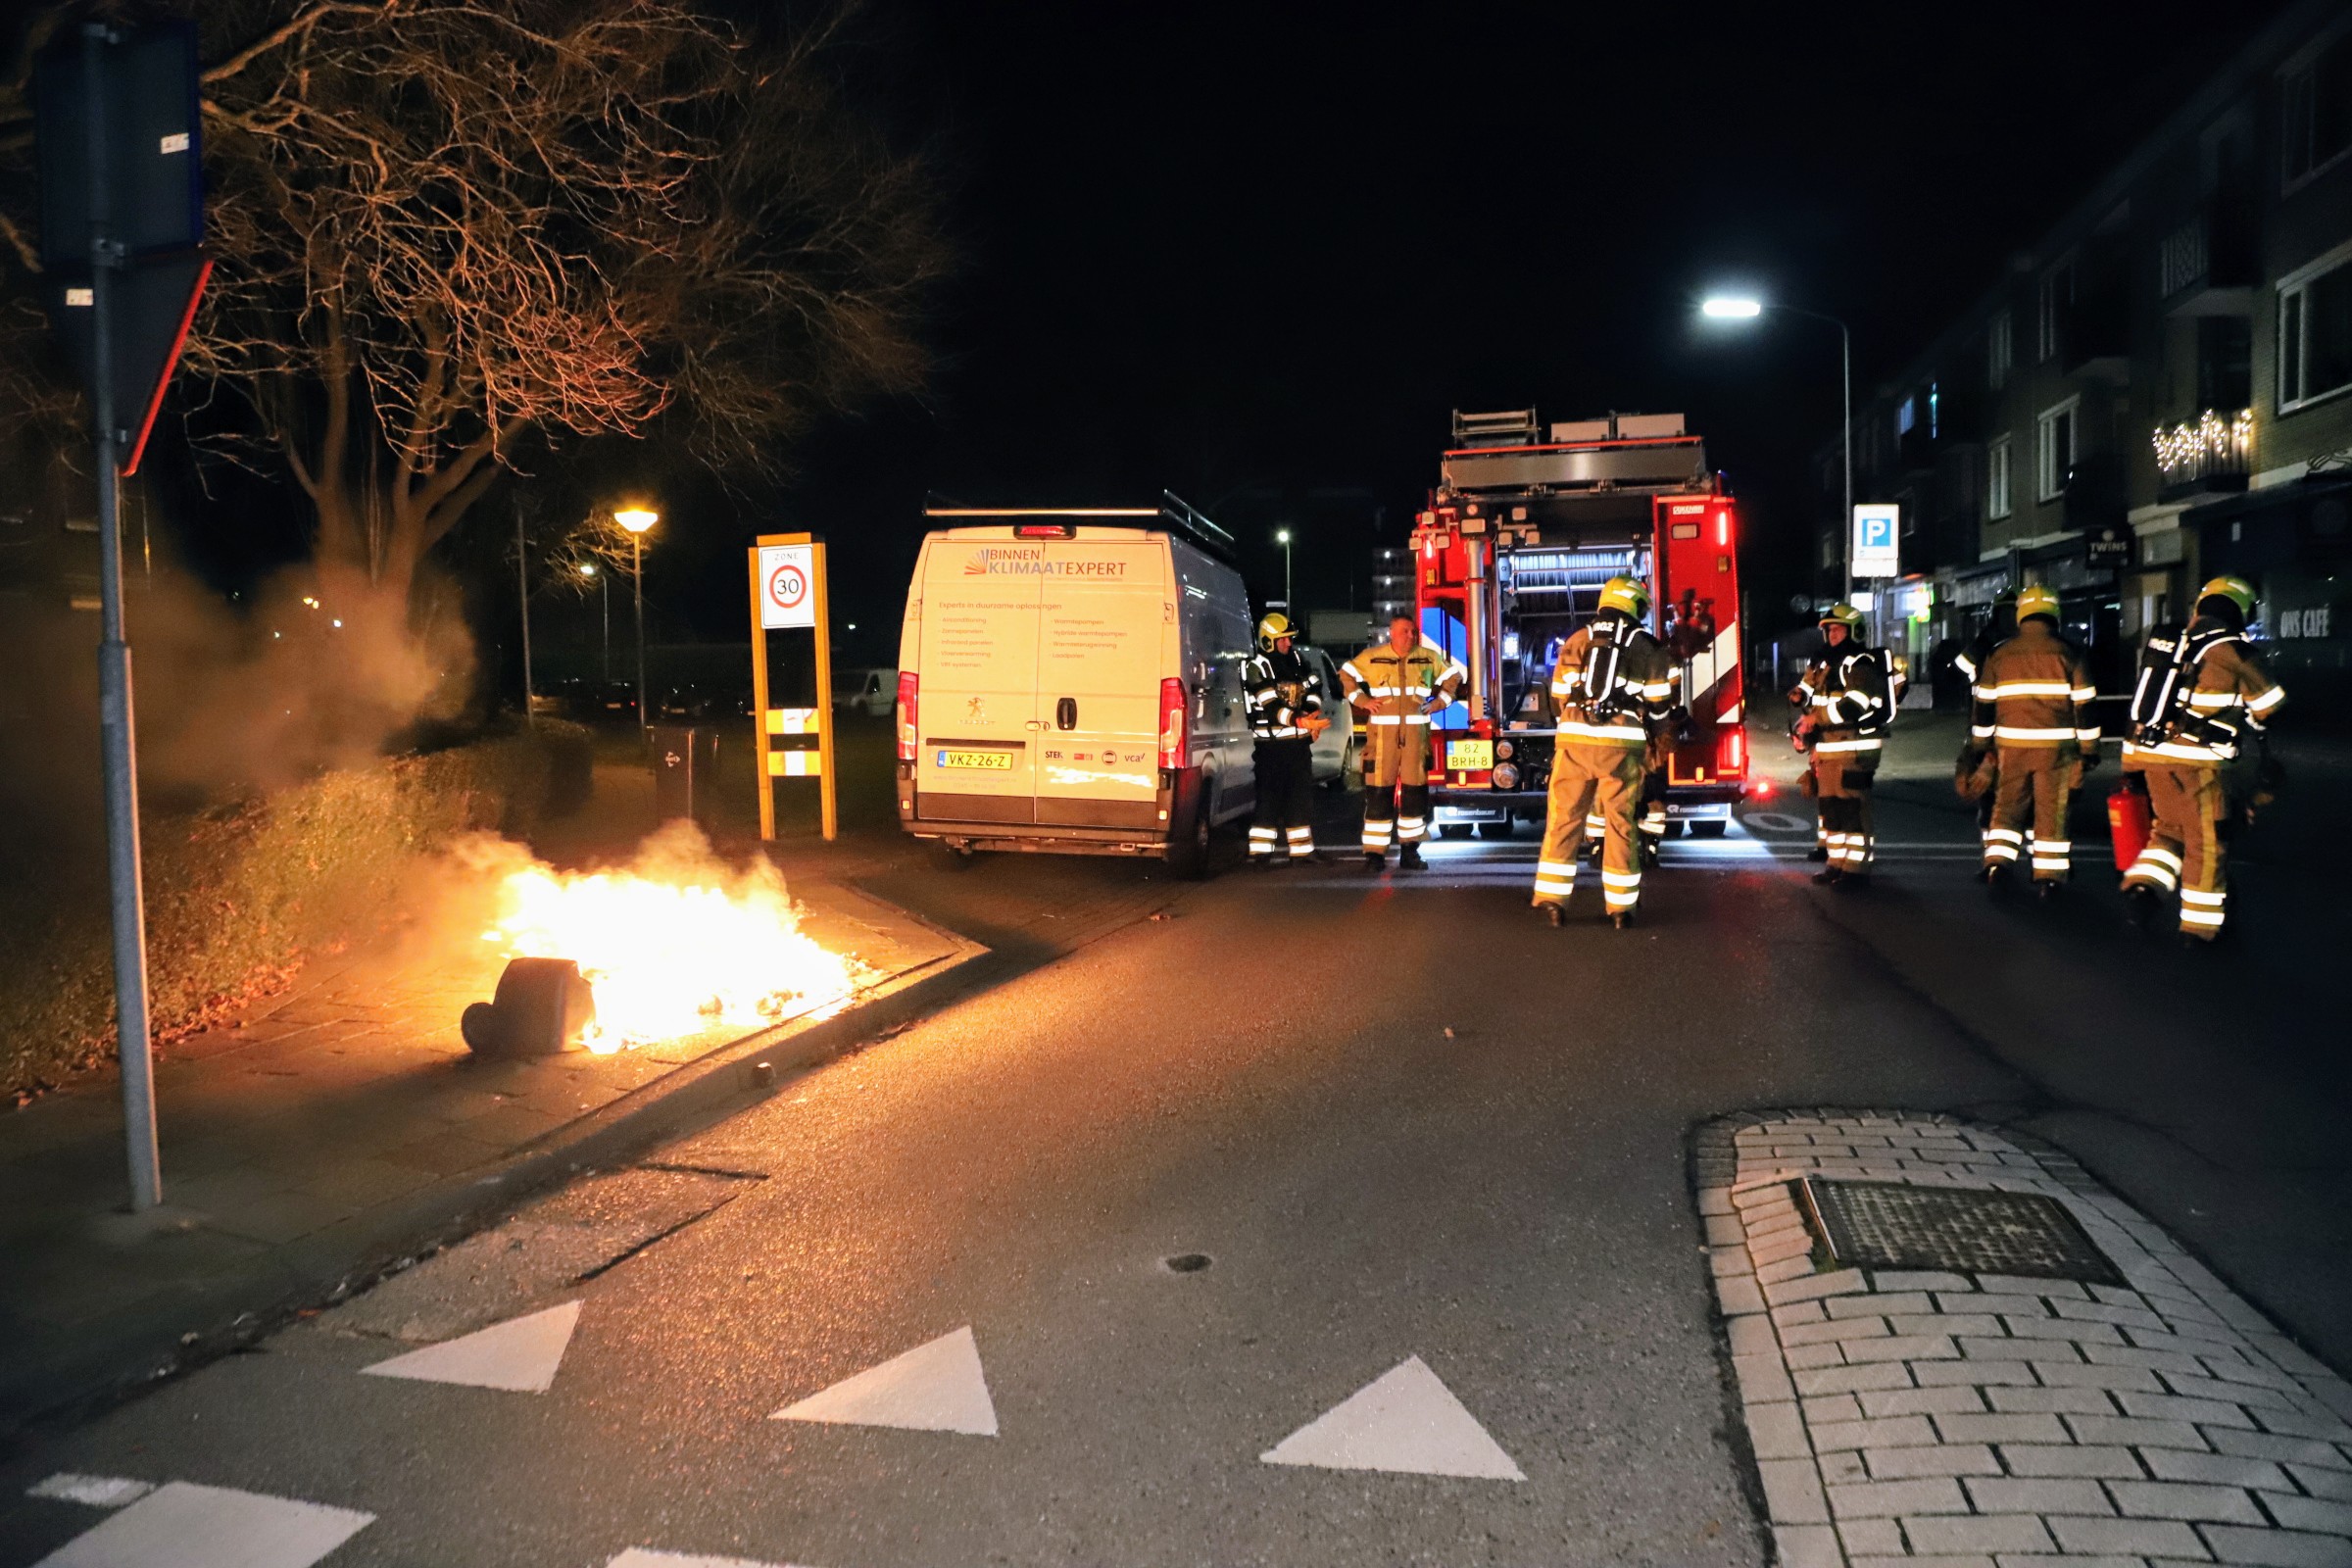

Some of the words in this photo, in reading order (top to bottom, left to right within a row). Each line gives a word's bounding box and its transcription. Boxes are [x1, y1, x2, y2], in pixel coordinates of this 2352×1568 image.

[1866, 519, 1886, 546] P
[2089, 542, 2127, 552] TWINS
[990, 549, 1041, 561] BINNEN
[989, 562, 1127, 576] KLIMAATEXPERT
[777, 578, 799, 595] 30
[2280, 610, 2300, 638] ONS
[1464, 743, 1479, 754] 82
[950, 754, 1005, 767] VKZ-26-Z
[1045, 750, 1064, 760] STEK
[1451, 756, 1488, 767] BRH-8
[1457, 808, 1496, 816] rosenbauer
